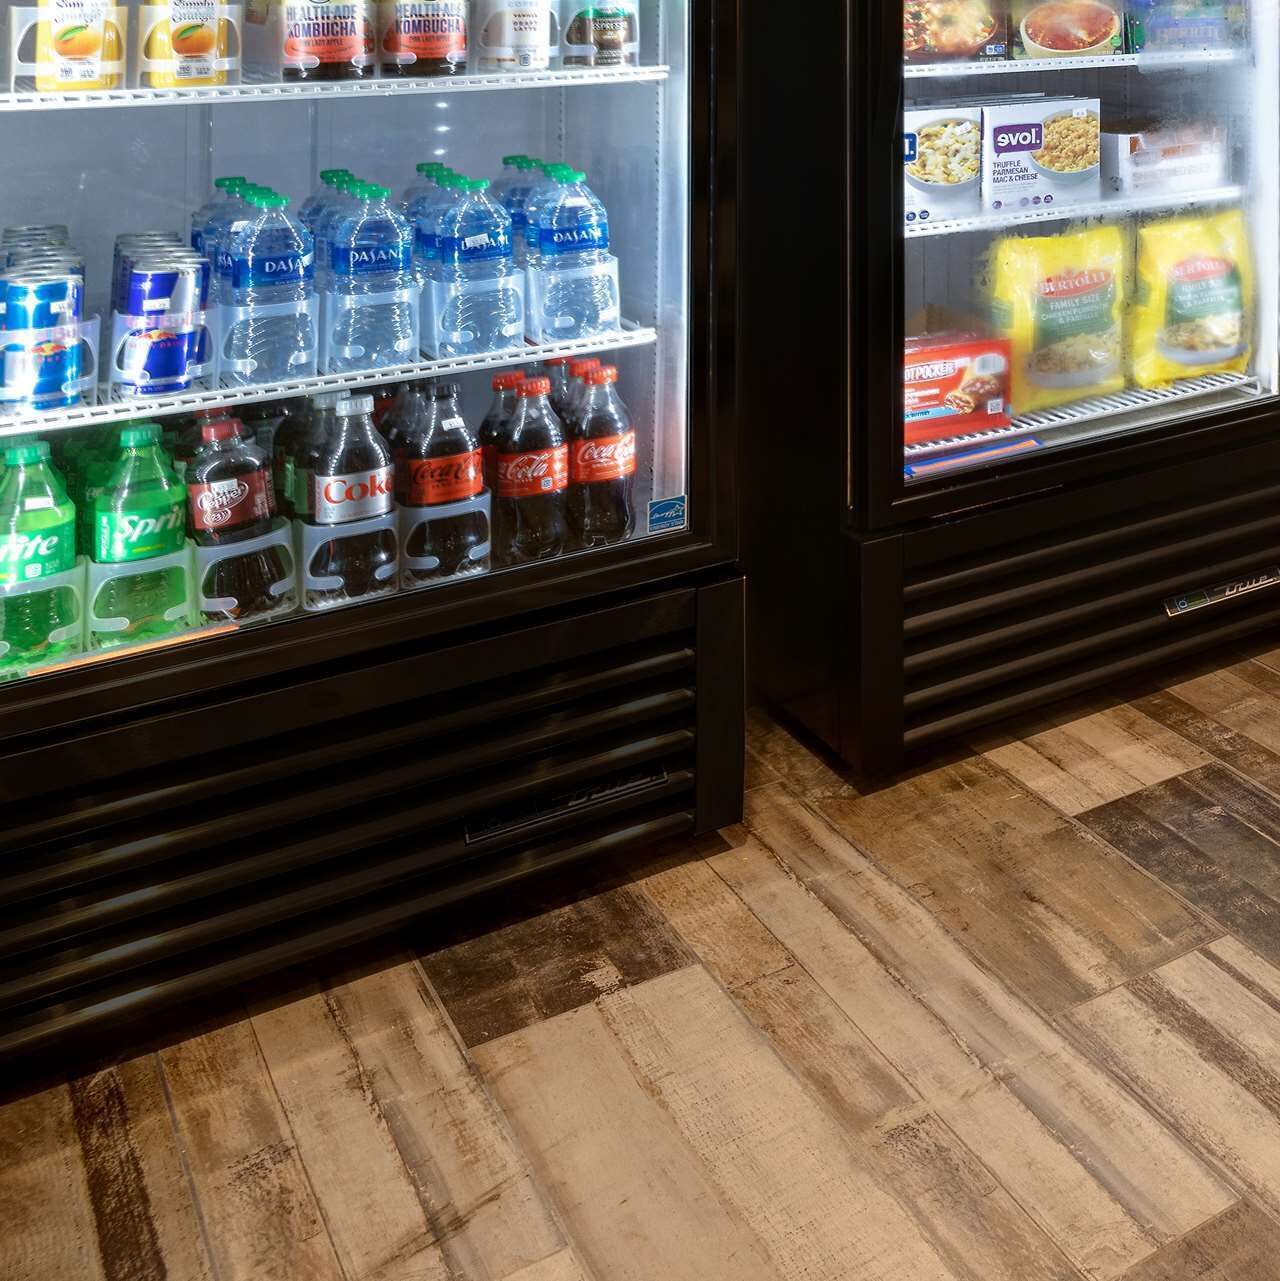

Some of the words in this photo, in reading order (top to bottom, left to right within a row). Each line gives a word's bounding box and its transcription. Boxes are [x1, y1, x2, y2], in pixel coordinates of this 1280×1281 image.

[286, 4, 357, 21] HEALTH-ADE
[288, 19, 357, 38] KOMBUCHA
[396, 20, 461, 34] KOMBUCHA
[997, 128, 1042, 148] evol.
[992, 160, 1021, 170] TRUFFLE
[992, 167, 1029, 176] PARMESAN
[992, 175, 1006, 184] MAC
[1013, 173, 1039, 182] CHEESE
